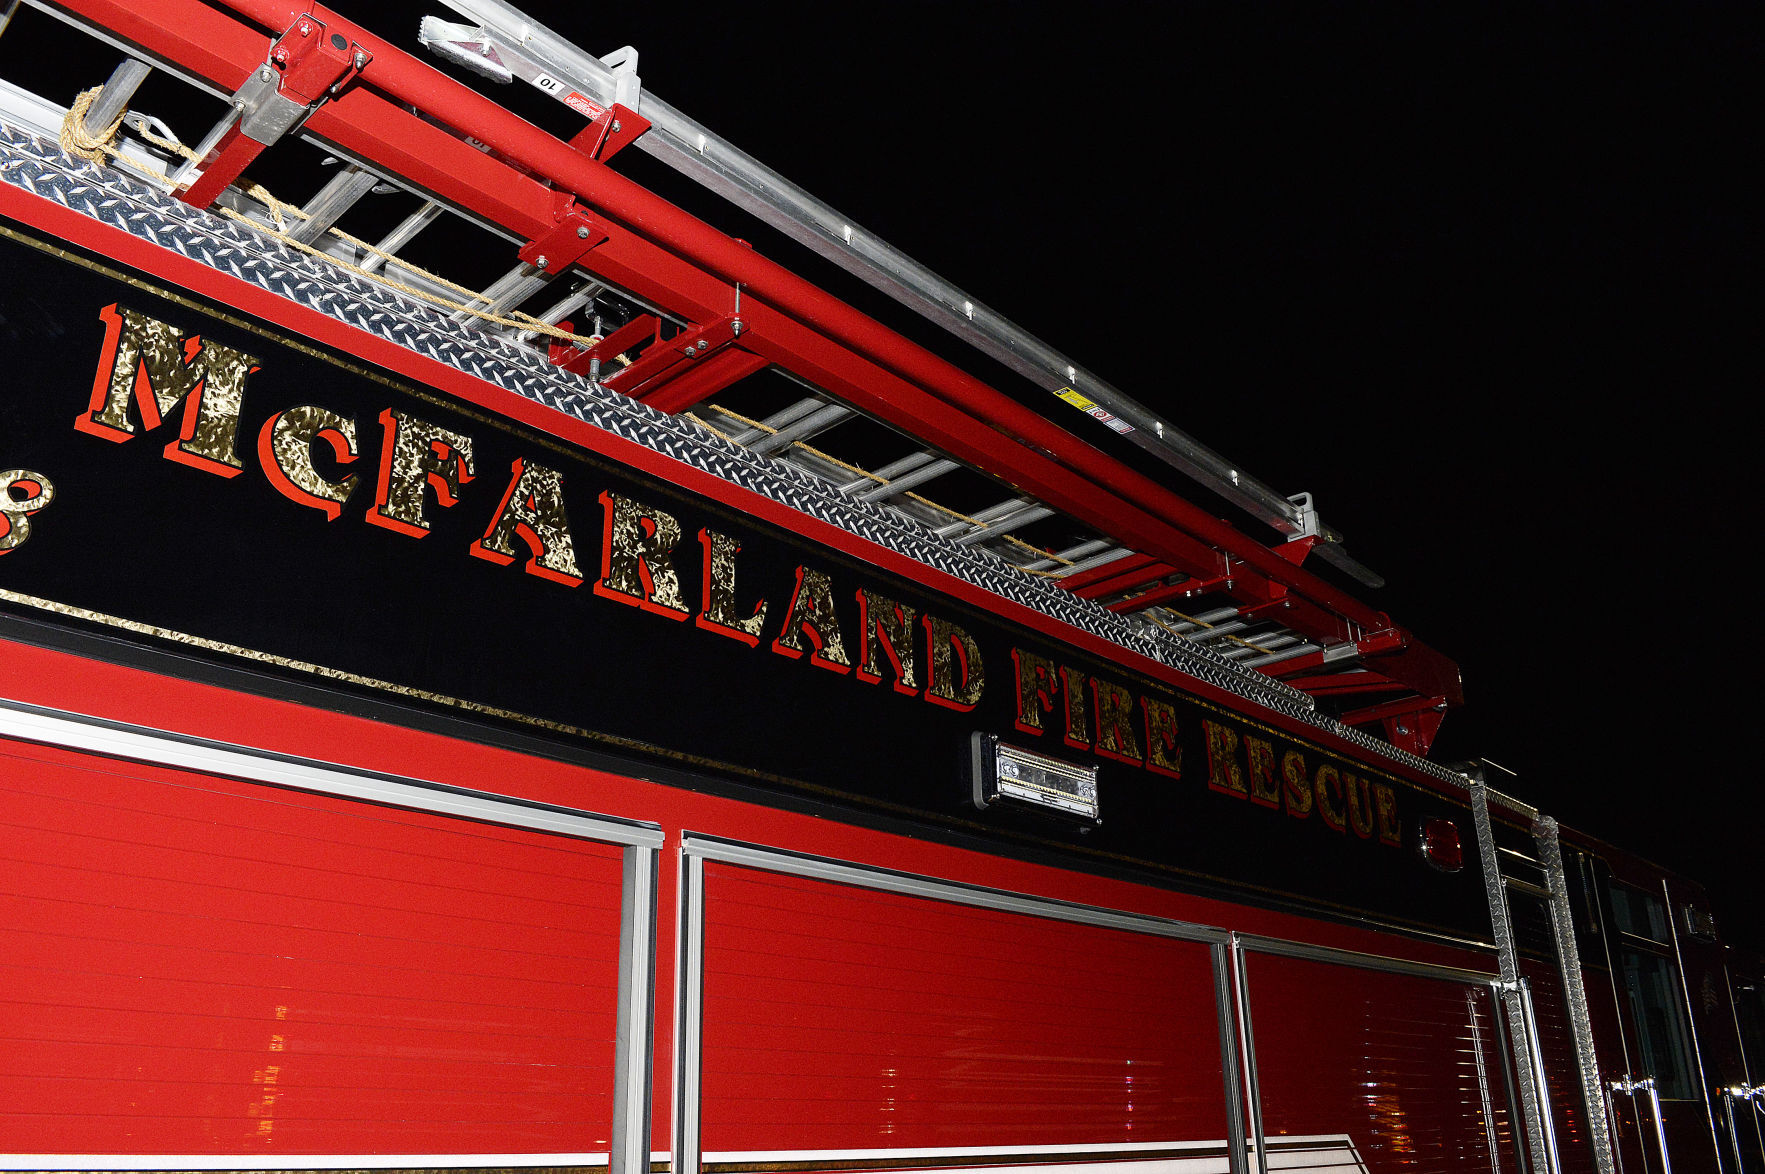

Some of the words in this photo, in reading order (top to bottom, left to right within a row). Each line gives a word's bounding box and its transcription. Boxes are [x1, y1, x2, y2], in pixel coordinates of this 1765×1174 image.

[540, 78, 556, 91] 10
[1010, 646, 1183, 780] FIRE
[1202, 719, 1404, 848] RESCUE
